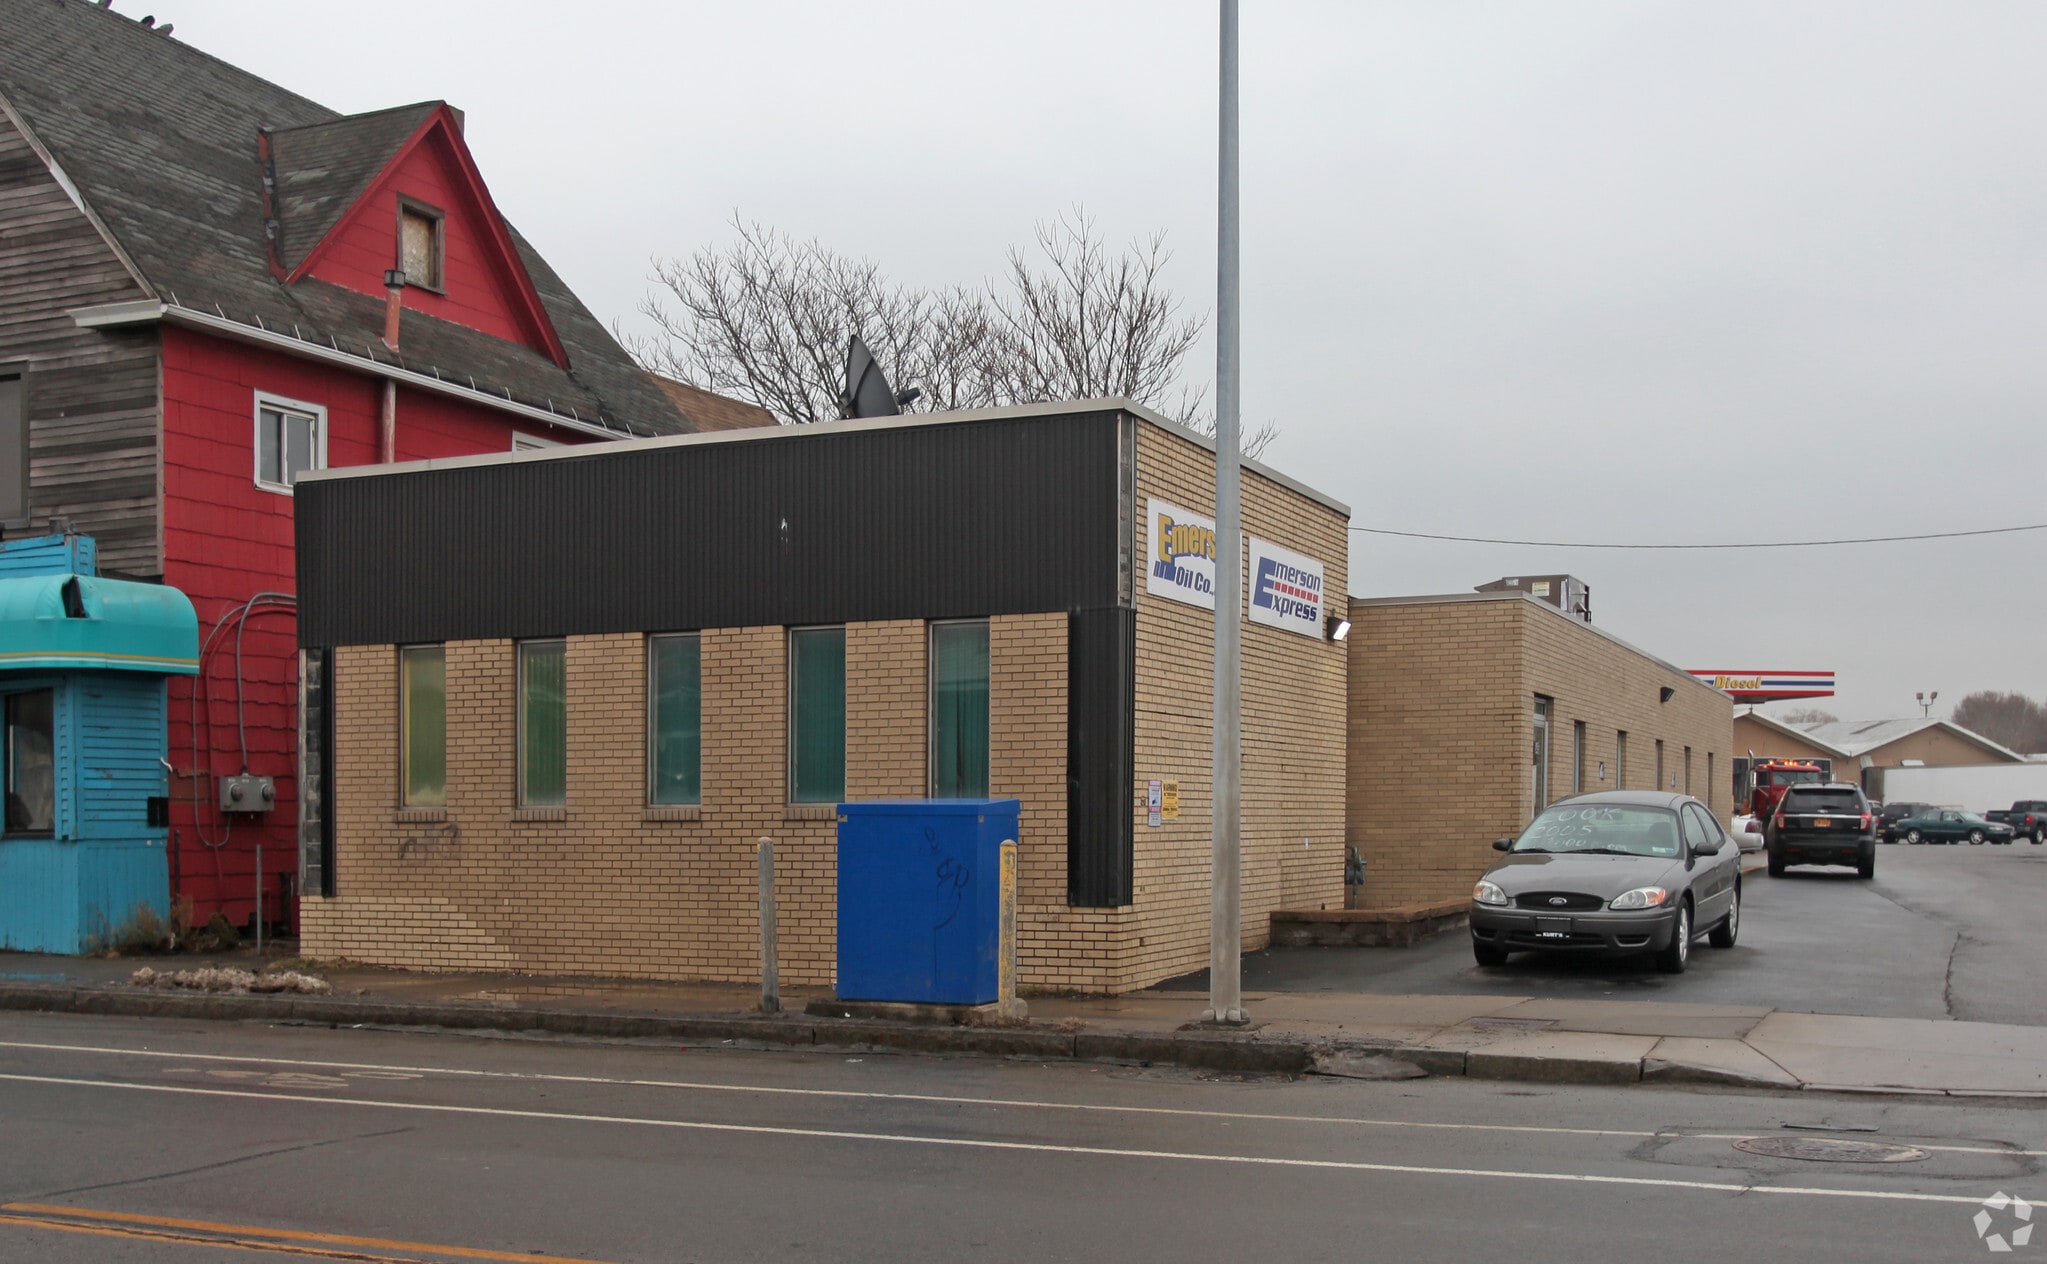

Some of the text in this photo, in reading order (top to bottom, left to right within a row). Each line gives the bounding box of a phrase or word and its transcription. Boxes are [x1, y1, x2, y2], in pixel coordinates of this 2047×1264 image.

[1157, 512, 1216, 564] Emers
[1175, 566, 1194, 588] Oil
[1253, 556, 1321, 603] Emerson
[1714, 675, 1762, 689] Diesel
